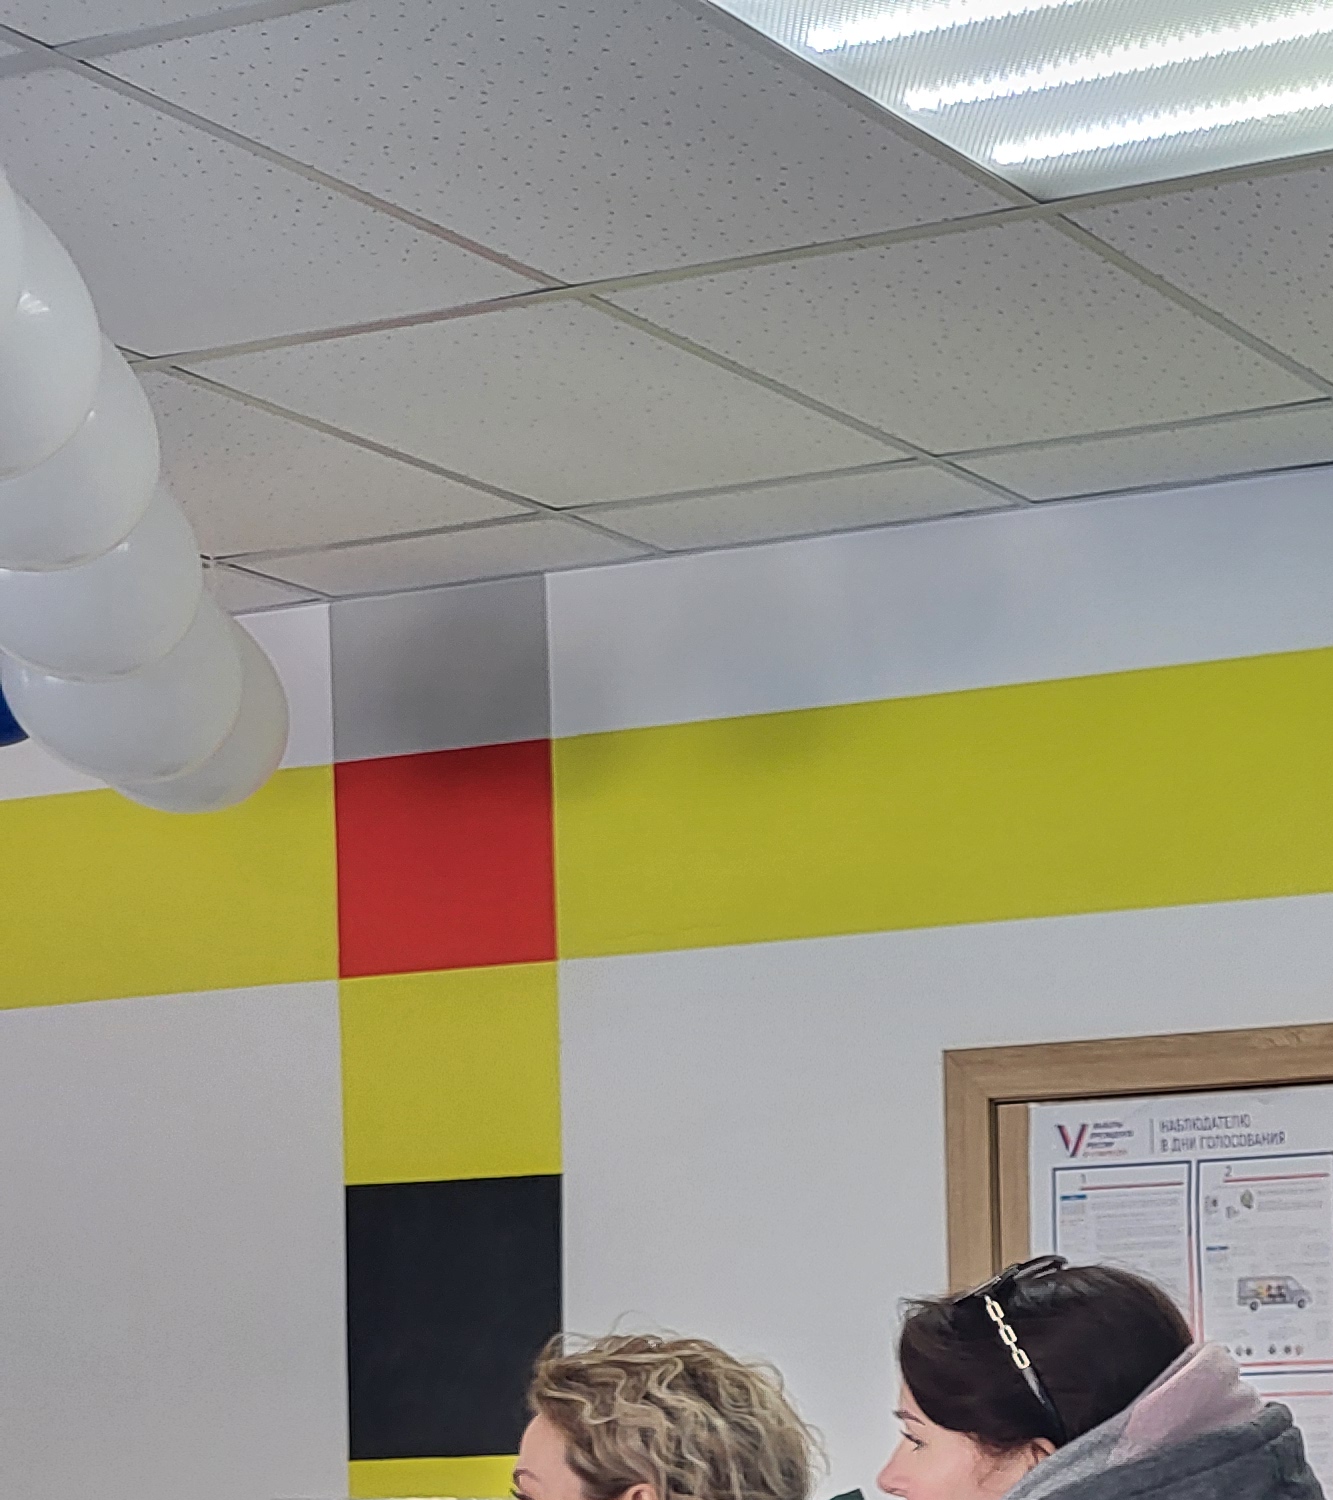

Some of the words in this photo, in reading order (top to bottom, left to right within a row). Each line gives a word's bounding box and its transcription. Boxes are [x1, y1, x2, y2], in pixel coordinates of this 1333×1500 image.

[1160, 1114, 1251, 1133] НАБЛЮДАТЕЛЮ
[1171, 1137, 1196, 1152] ДНИ
[1199, 1131, 1285, 1150] ГОЛОСОВАНИЯ
